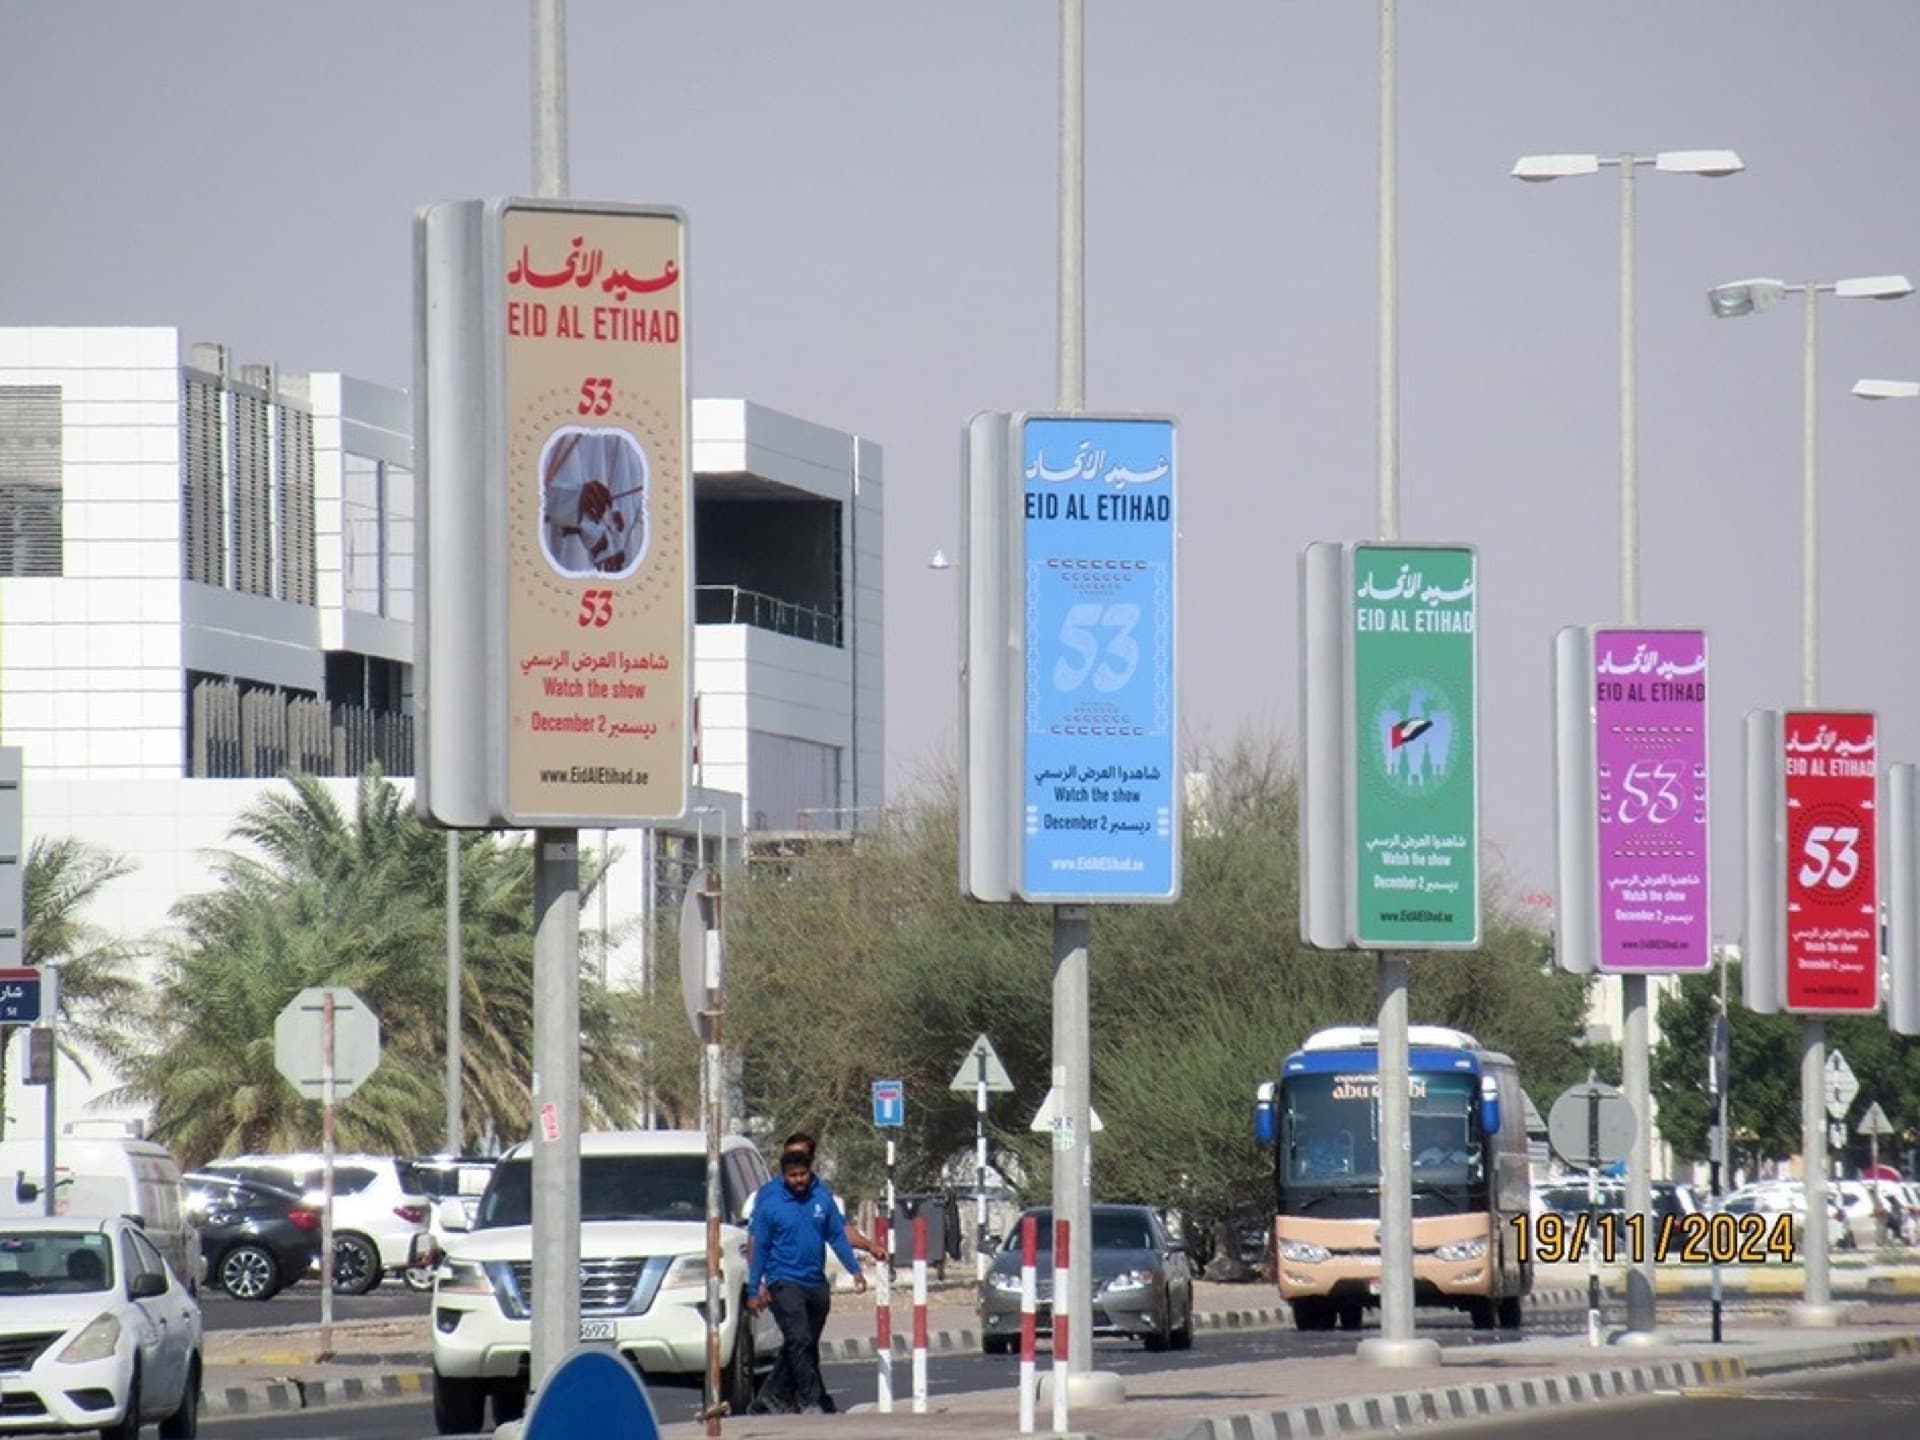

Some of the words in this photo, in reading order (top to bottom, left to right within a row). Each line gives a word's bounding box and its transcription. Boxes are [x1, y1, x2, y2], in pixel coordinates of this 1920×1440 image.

[602, 259, 679, 301] عيد
[508, 302, 547, 337] EID
[556, 304, 585, 339] AL
[594, 306, 679, 343] ETIHAD
[578, 377, 612, 416] 53
[1104, 455, 1169, 490] عيد
[1024, 493, 1058, 519] EID
[1066, 493, 1089, 520] AL
[1097, 494, 1170, 521] ETIHAD
[1421, 578, 1474, 607] عيد
[578, 589, 613, 627] 53
[1357, 608, 1385, 631] EID
[1391, 608, 1410, 632] AL
[1415, 609, 1473, 633] ETIHAD
[1053, 603, 1141, 693] 53
[520, 650, 570, 675] الرسمي
[573, 652, 616, 672] العرض
[620, 653, 669, 673] شاهدوا
[1656, 655, 1706, 681] عيد
[544, 677, 583, 697] Watch
[588, 679, 608, 698] the
[613, 680, 646, 699] show
[1597, 682, 1622, 702] EID
[1628, 682, 1647, 702] AL
[1651, 682, 1705, 702] ETIHAD
[531, 711, 594, 733] December
[598, 714, 605, 733] 2
[608, 723, 656, 739] ديسمبر
[540, 766, 648, 785] www.EidAlEtihad.ae
[1034, 765, 1077, 786] الرسمي
[1078, 765, 1116, 782] العرض
[1118, 766, 1161, 783] شاهدوا
[1786, 757, 1807, 776] EID
[1811, 758, 1827, 777] AL
[1830, 758, 1876, 777] ETIHAD
[1054, 786, 1089, 802] Watch
[1092, 787, 1109, 802] the
[1113, 787, 1140, 802] show
[1618, 760, 1685, 824] 53
[1043, 813, 1098, 830] December
[1101, 815, 1108, 831] 2
[1109, 821, 1152, 835] ديسمبر
[1382, 851, 1410, 866] Watch
[1411, 852, 1425, 866] the
[1428, 853, 1451, 866] show
[1799, 826, 1860, 889] 53
[1373, 874, 1417, 889] December
[1418, 875, 1425, 890] 2
[0, 985, 24, 1003] شار
[1332, 1080, 1368, 1100] abu
